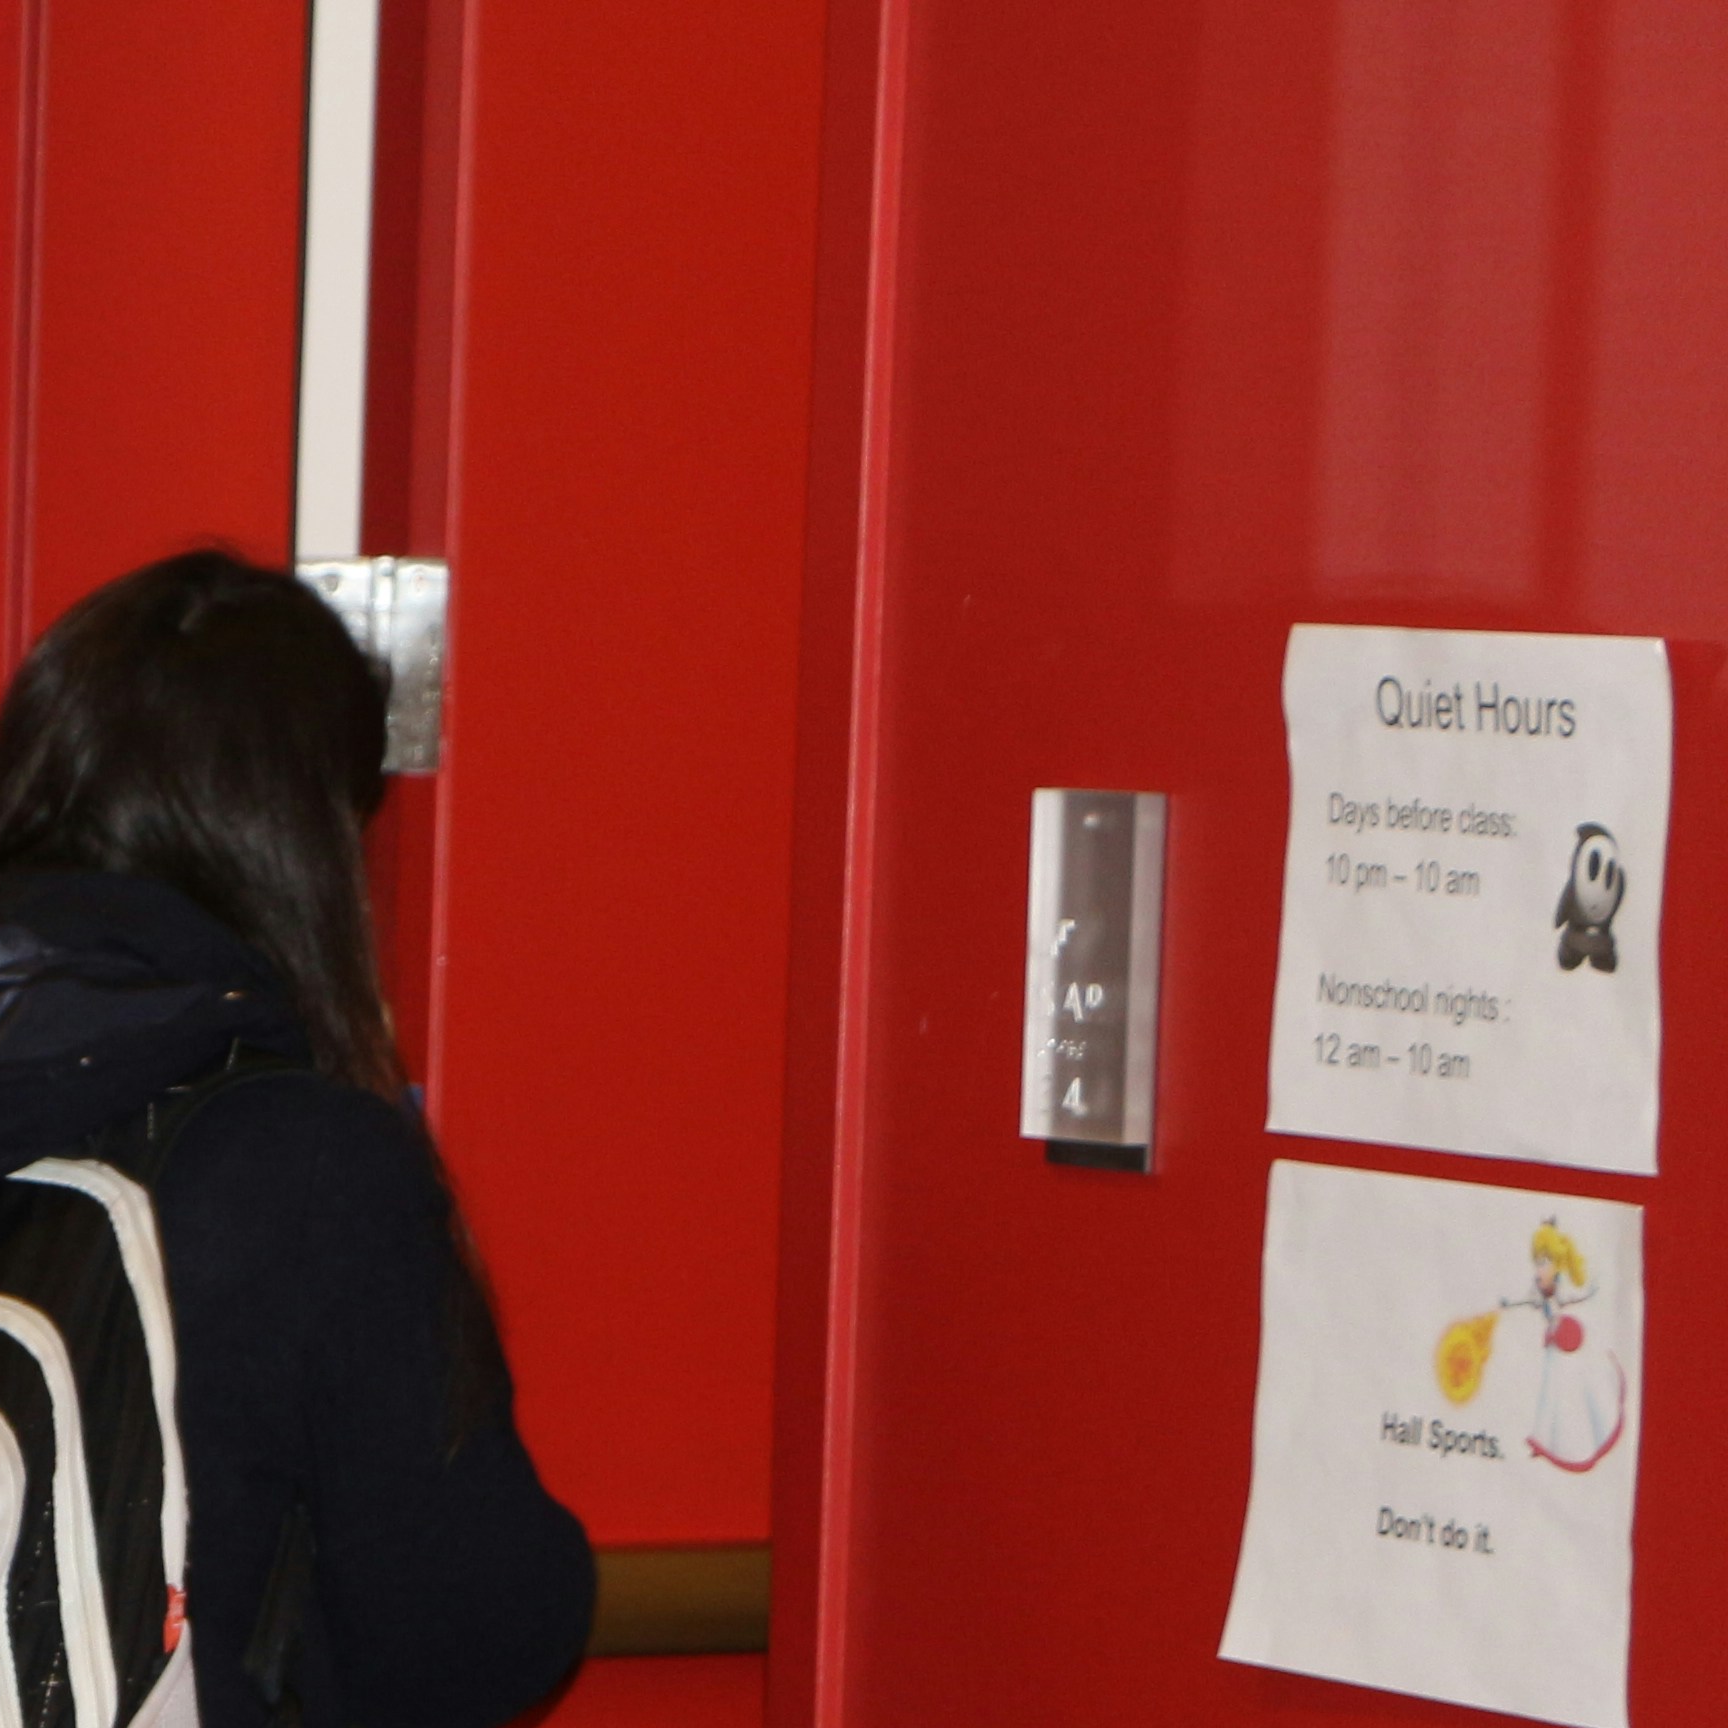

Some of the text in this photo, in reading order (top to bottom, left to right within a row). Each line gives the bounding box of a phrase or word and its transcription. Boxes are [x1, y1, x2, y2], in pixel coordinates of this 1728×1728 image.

[1375, 675, 1577, 740] Quiet Hours
[1328, 791, 1381, 834] Days
[1386, 797, 1453, 834] before
[1326, 852, 1350, 886] 10
[1355, 861, 1387, 894] pm
[1415, 860, 1440, 894] 10
[1445, 869, 1480, 896] am
[1318, 972, 1429, 1014] Nonschool
[1314, 1032, 1341, 1067] 12
[1346, 1042, 1381, 1068] am
[1407, 1042, 1432, 1076] 10
[1437, 1051, 1470, 1079] am
[1380, 1411, 1506, 1460] Hall Sports.
[1376, 1506, 1496, 1555] Don't do it.
